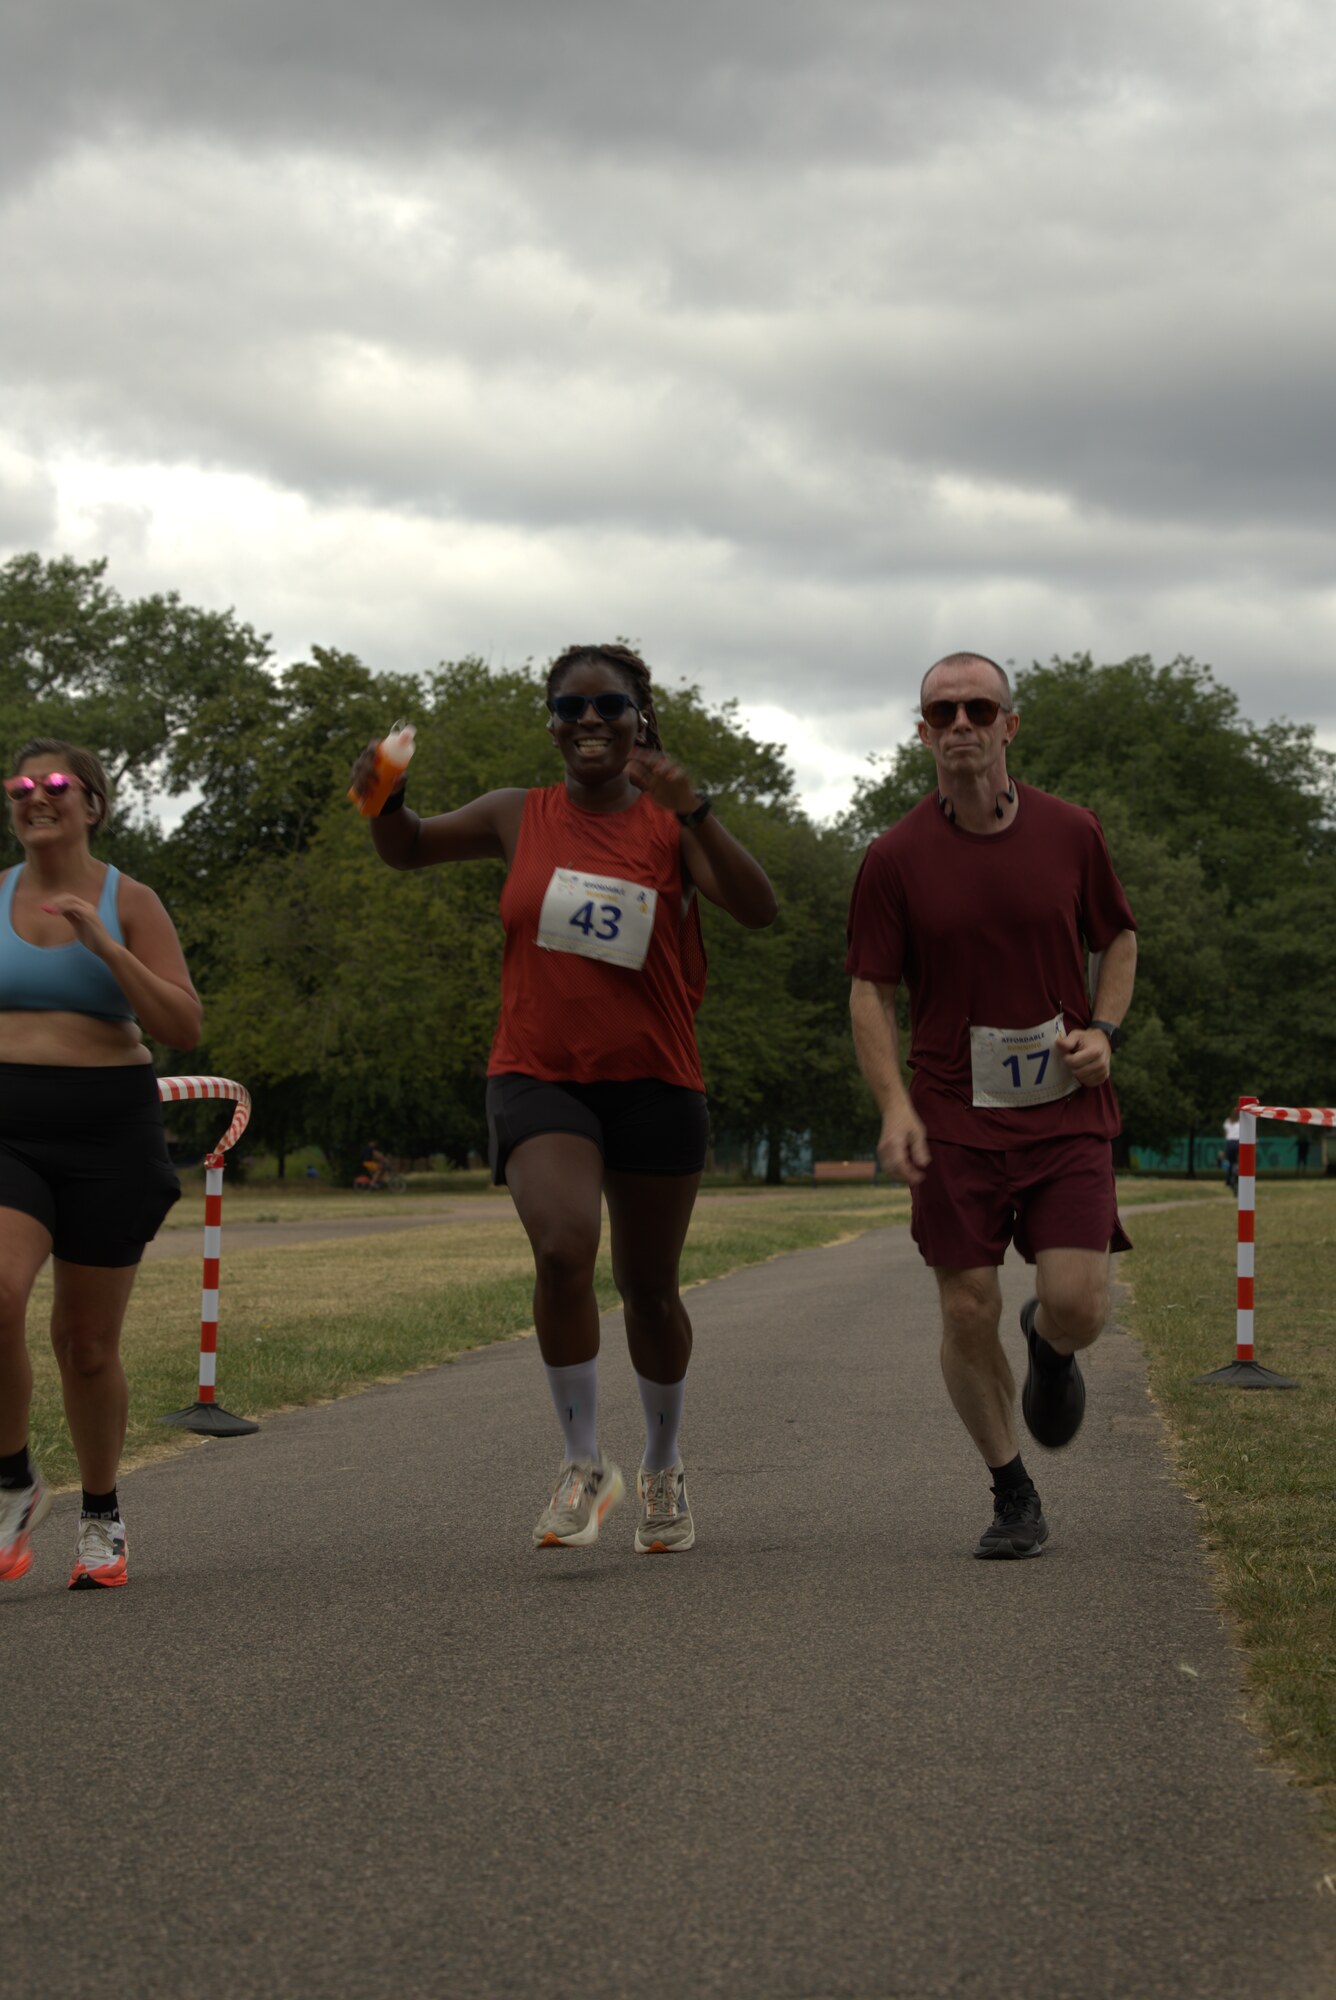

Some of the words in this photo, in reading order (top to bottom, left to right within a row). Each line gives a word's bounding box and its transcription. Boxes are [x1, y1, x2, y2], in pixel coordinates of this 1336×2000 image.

[569, 900, 623, 941] 43
[1001, 1032, 1045, 1044] AFFORDABLE
[1002, 1048, 1050, 1088] 17
